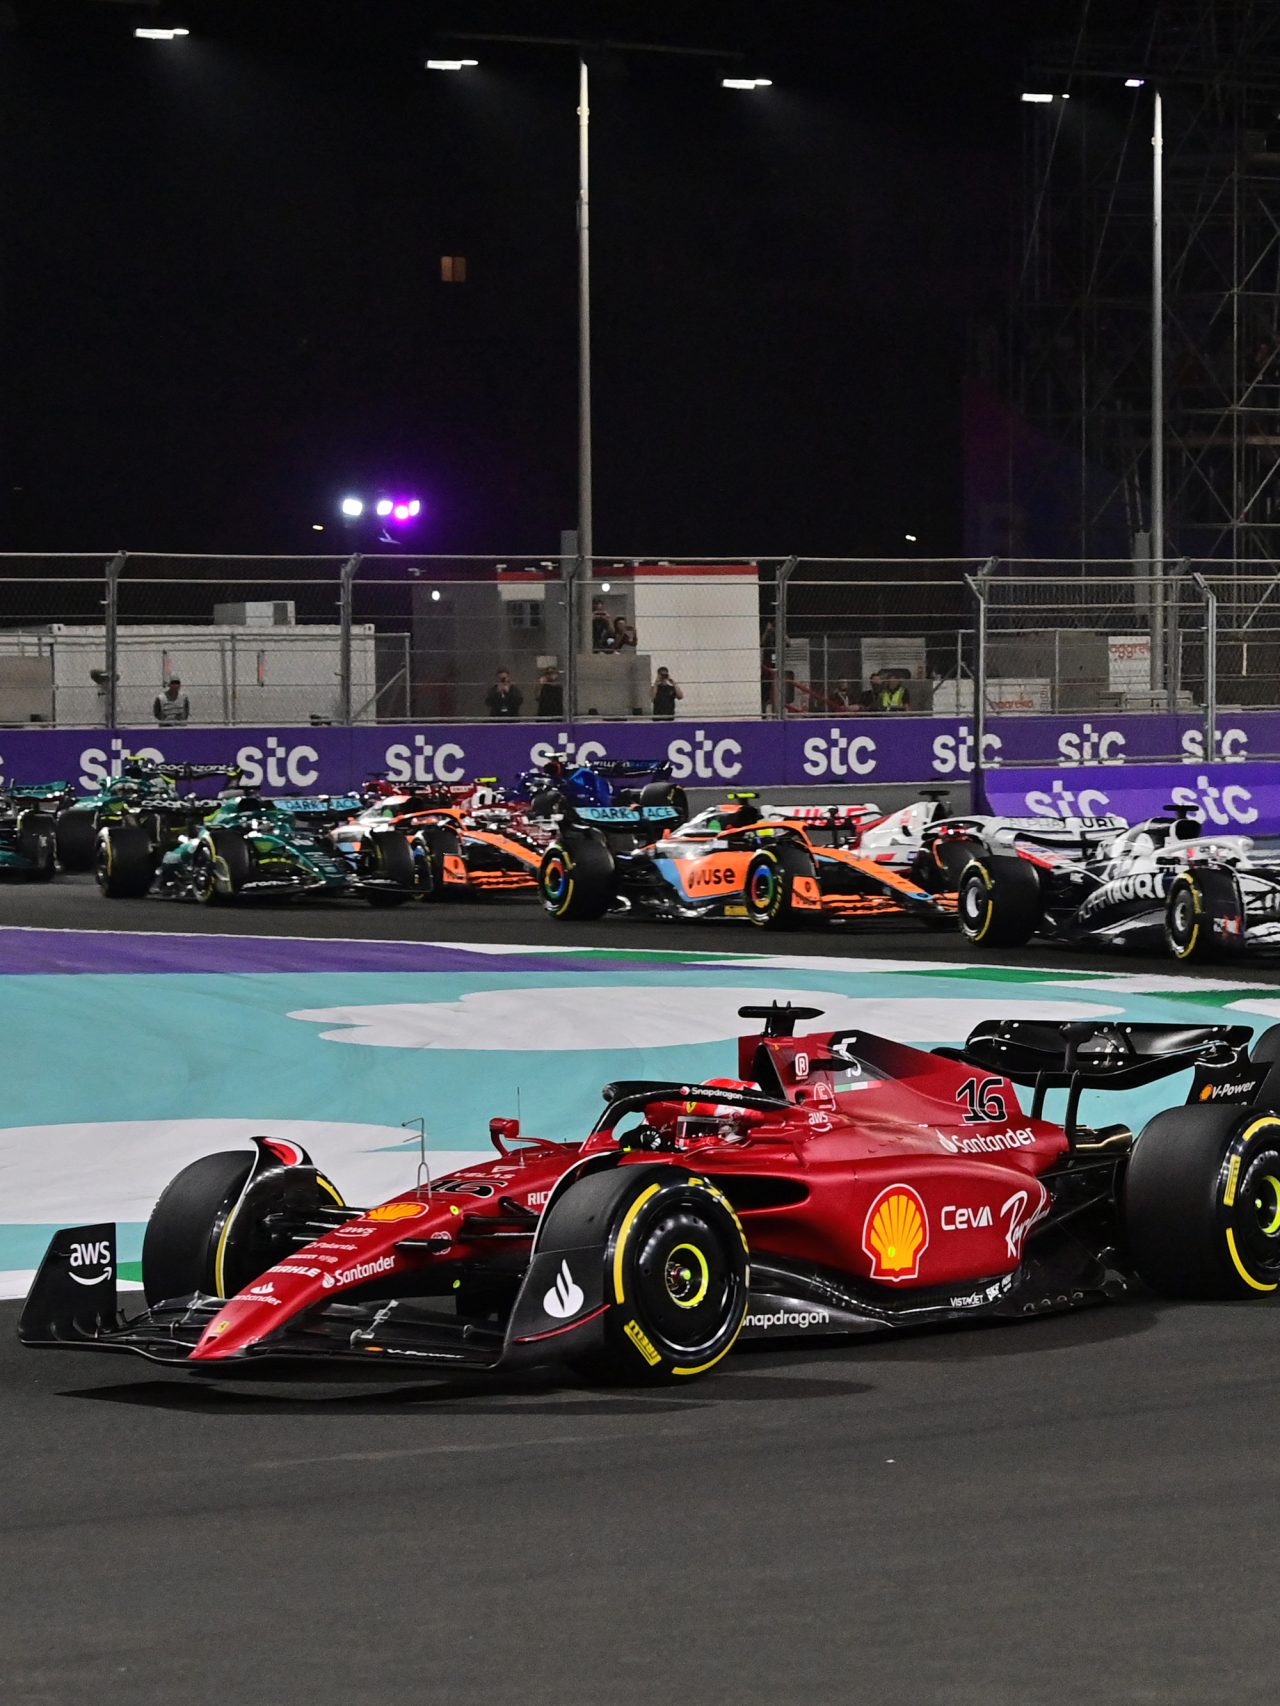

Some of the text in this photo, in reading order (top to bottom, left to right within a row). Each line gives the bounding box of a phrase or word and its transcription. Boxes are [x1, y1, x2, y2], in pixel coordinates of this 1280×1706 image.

[236, 737, 319, 786] stc
[385, 735, 464, 782] stc
[667, 730, 742, 778] stc
[803, 728, 876, 775] stc
[932, 726, 1002, 773] stc
[1058, 723, 1126, 767] stc
[1025, 780, 1119, 818] stc
[1171, 776, 1258, 825] stc
[691, 1086, 743, 1100] Snapdragon
[956, 1076, 1007, 1123] 16
[1211, 1080, 1255, 1100] V-Power
[952, 1127, 1036, 1154] Santander
[69, 1241, 111, 1266] aws
[336, 1255, 395, 1286] Santander
